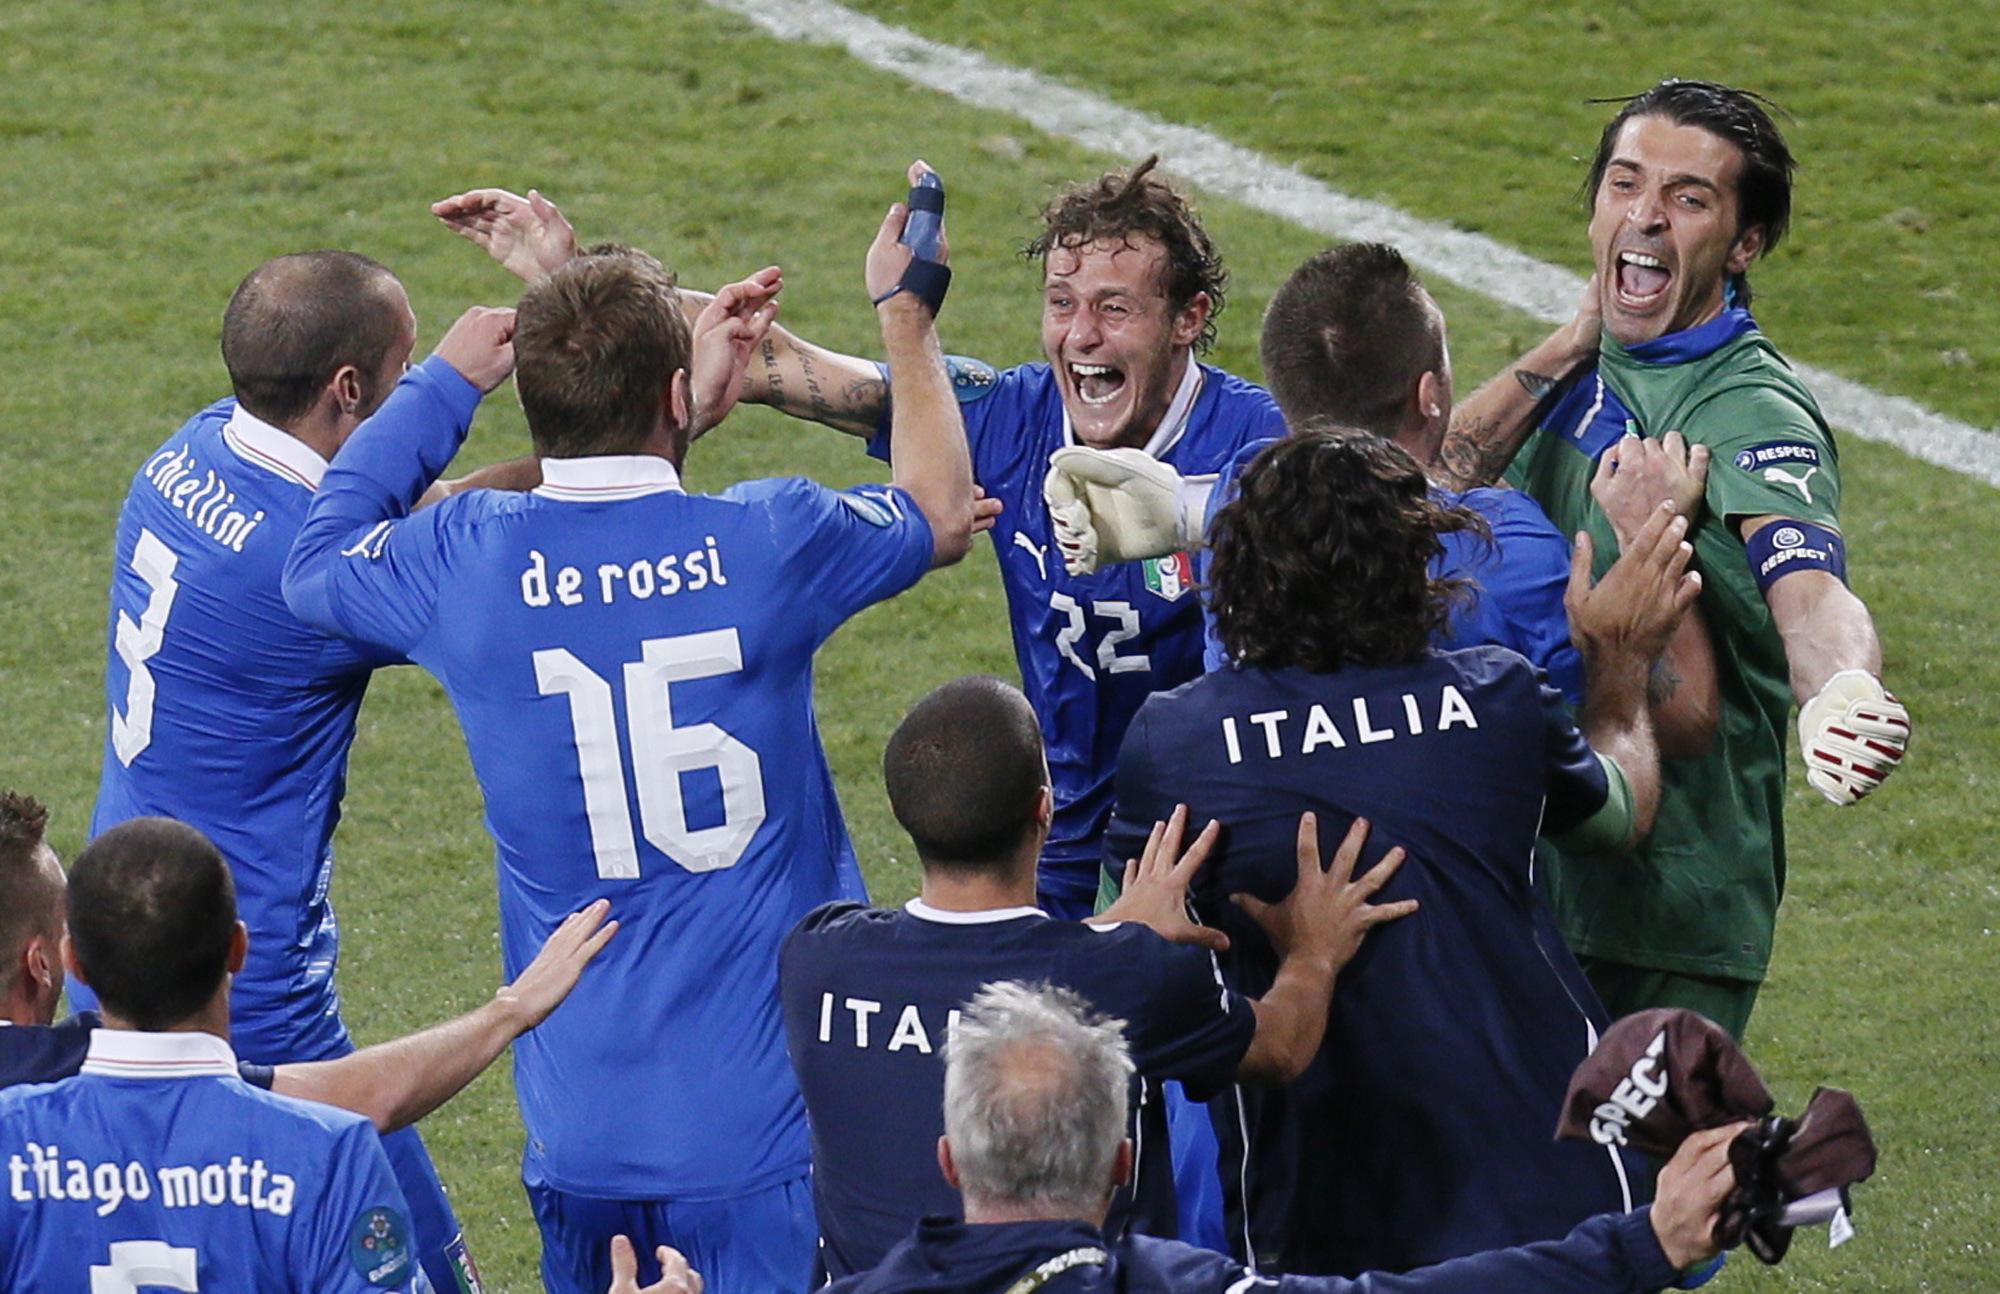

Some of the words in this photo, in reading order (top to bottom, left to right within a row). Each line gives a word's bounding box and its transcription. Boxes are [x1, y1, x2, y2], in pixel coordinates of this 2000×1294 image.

[1756, 446, 1817, 462] RESPECT
[145, 443, 266, 552] chiellini
[520, 550, 584, 607] de
[598, 535, 728, 604] rossi
[1760, 548, 1828, 576] RESPECT
[111, 526, 180, 769] 3
[1050, 590, 1152, 682] 22
[531, 626, 768, 880] 16
[1221, 685, 1479, 765] ITALIA
[7, 1142, 151, 1217] thiago
[157, 1155, 297, 1217] motta
